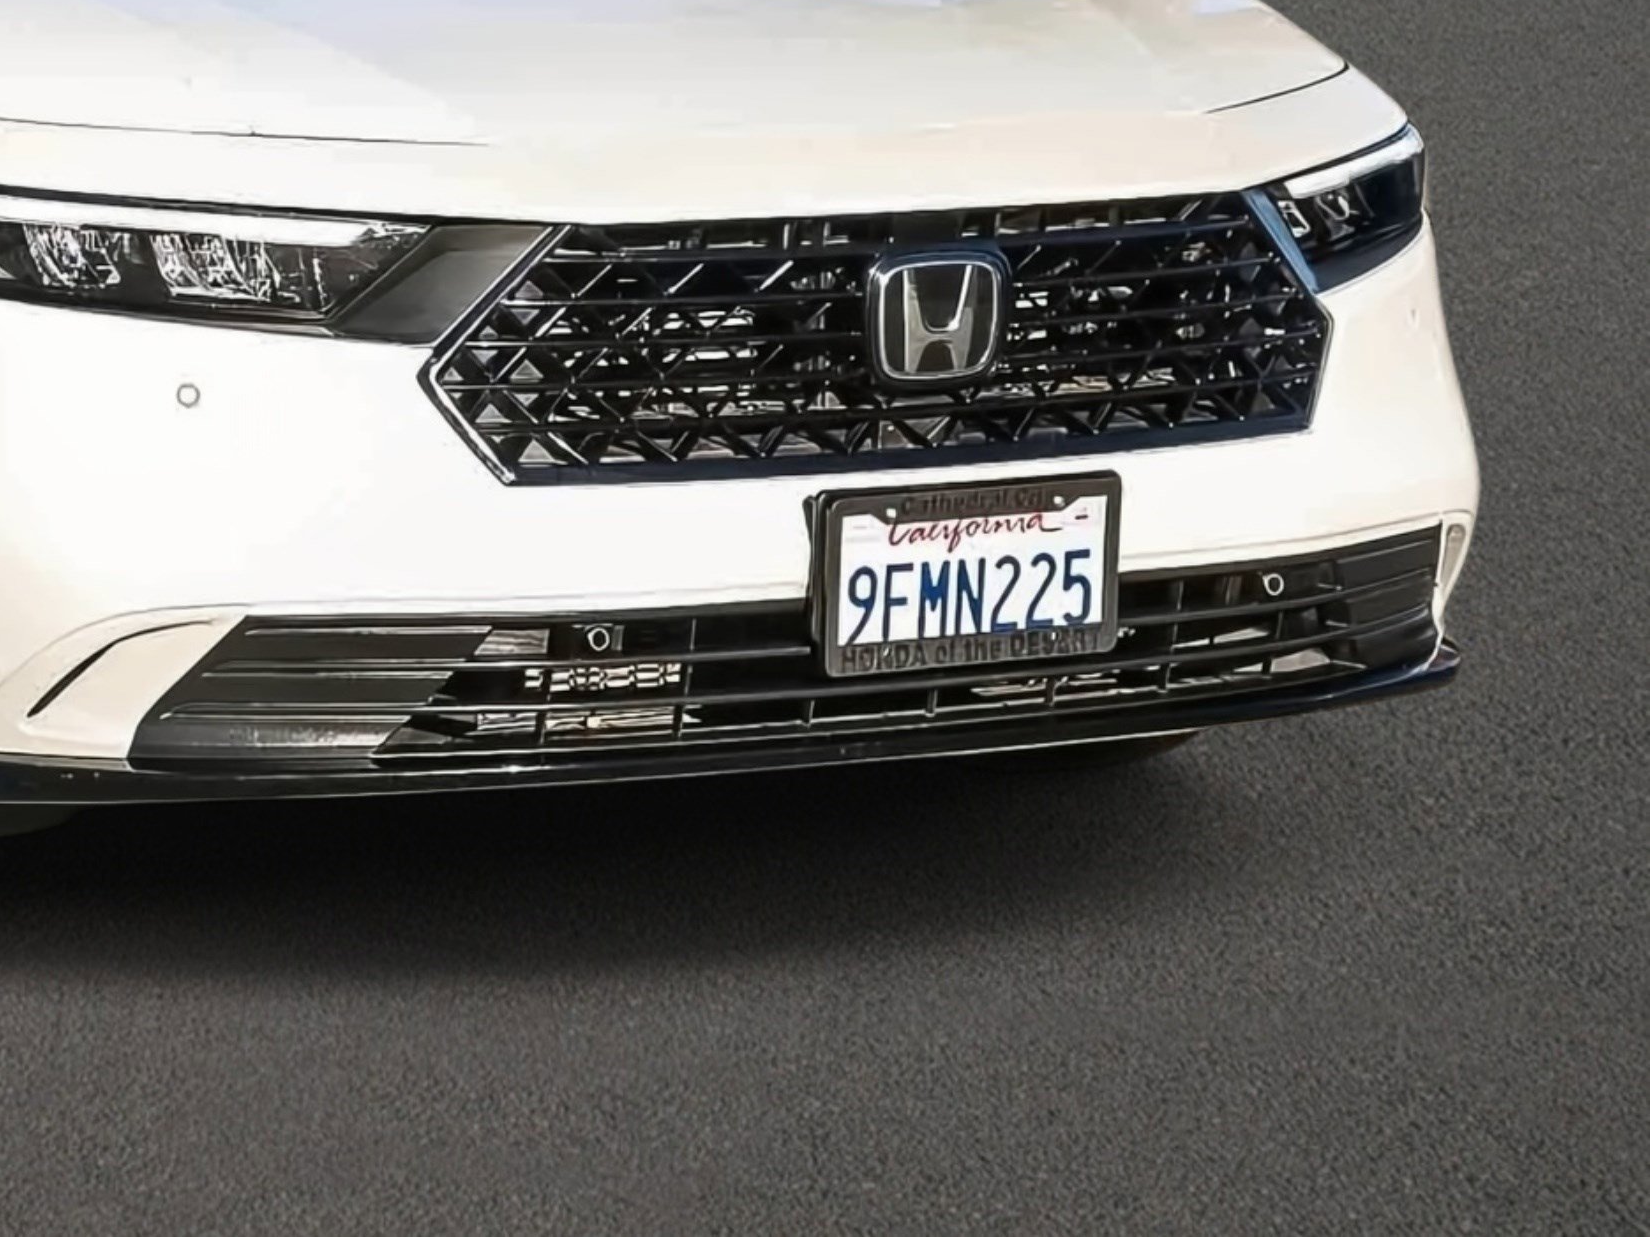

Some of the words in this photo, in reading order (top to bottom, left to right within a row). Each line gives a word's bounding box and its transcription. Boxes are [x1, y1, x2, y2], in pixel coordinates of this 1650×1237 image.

[888, 513, 1062, 553] California
[845, 548, 1092, 646] 9FMN225
[841, 642, 927, 674] HONDA
